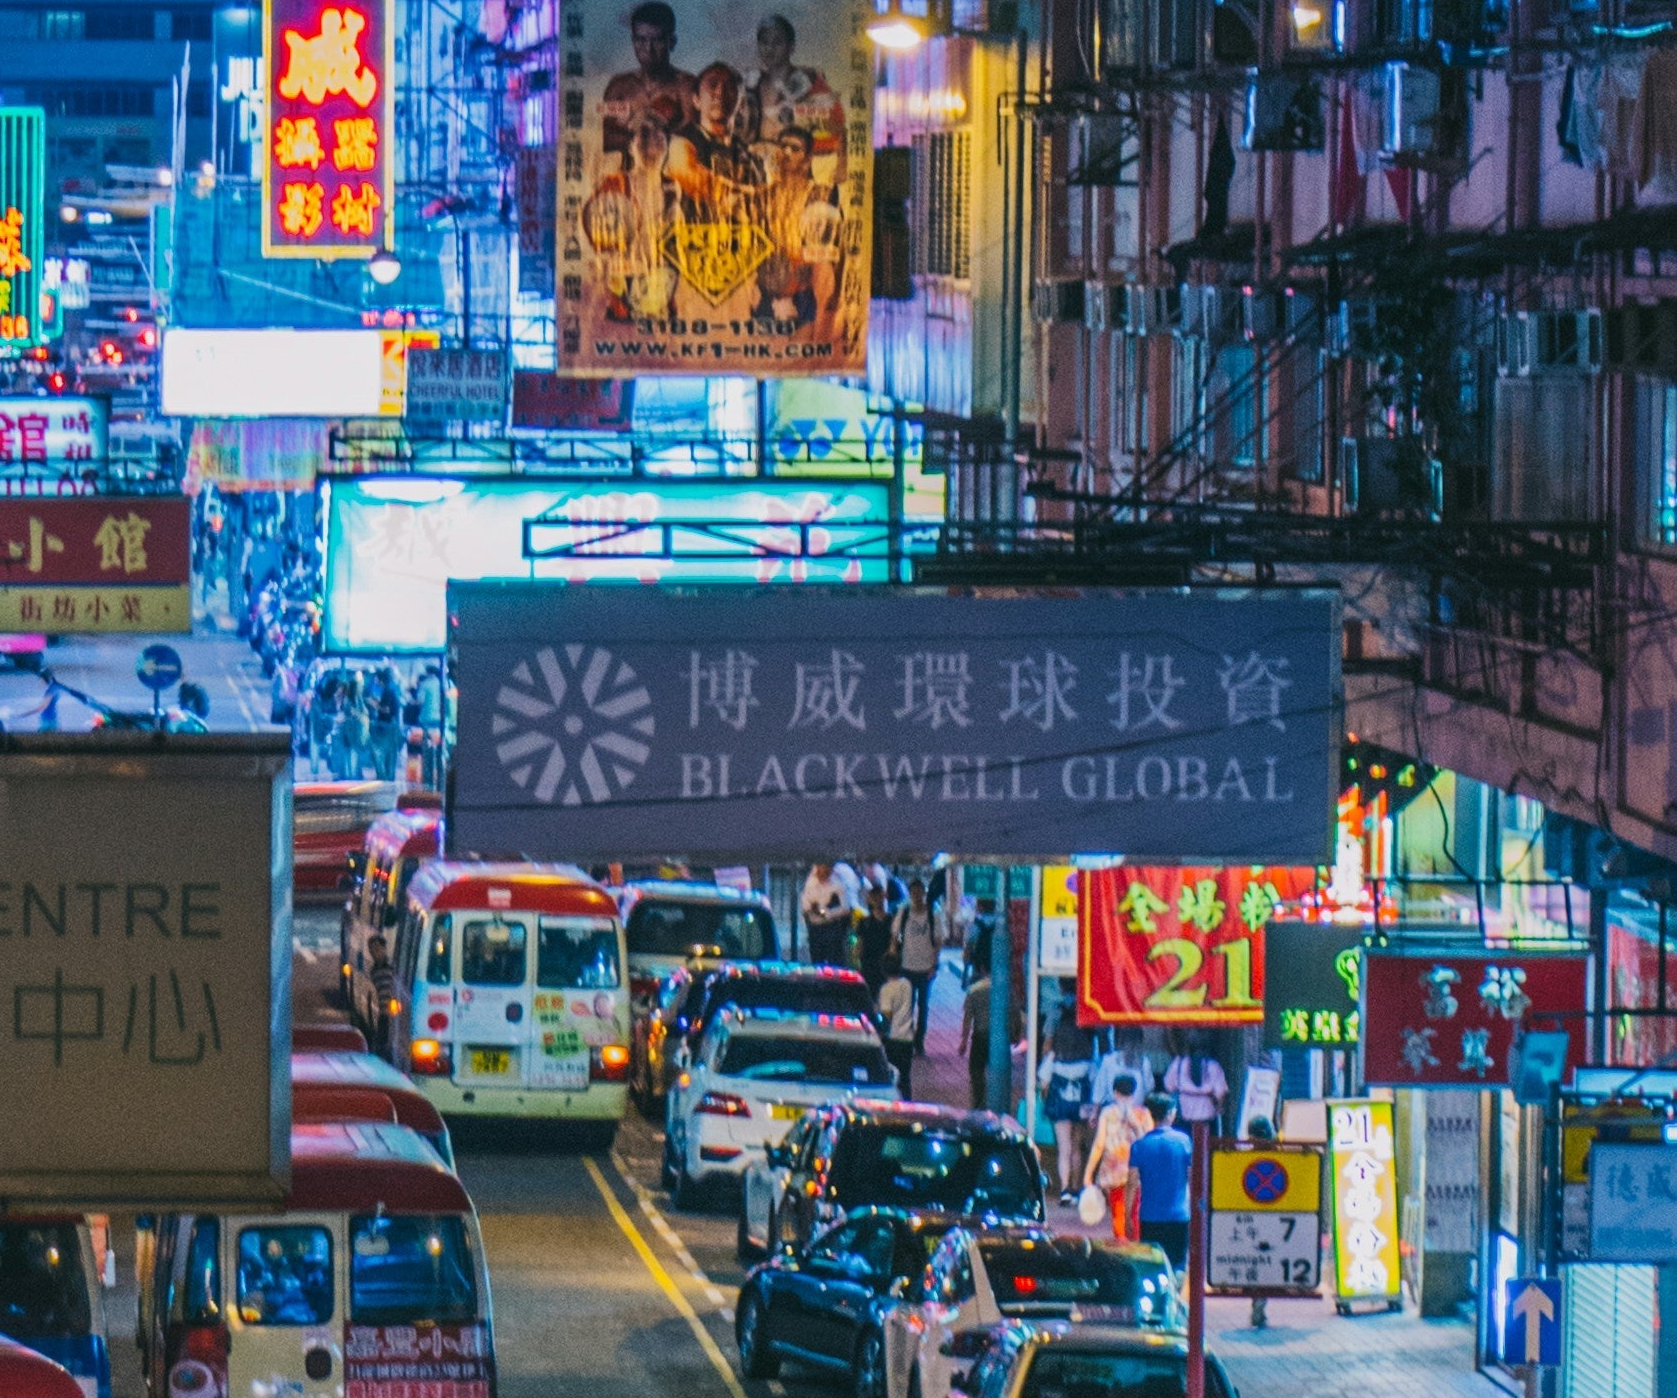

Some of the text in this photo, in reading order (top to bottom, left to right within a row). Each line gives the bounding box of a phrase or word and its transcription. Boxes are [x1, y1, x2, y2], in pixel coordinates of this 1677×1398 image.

[466, 384, 500, 399] HOTEL
[679, 649, 1295, 734] 博威環球投資
[679, 755, 1296, 801] BLACKWELL GLOBAL
[1144, 936, 1263, 1008] 21
[1279, 1217, 1297, 1242] 7
[1215, 1255, 1312, 1283] midnight 12
